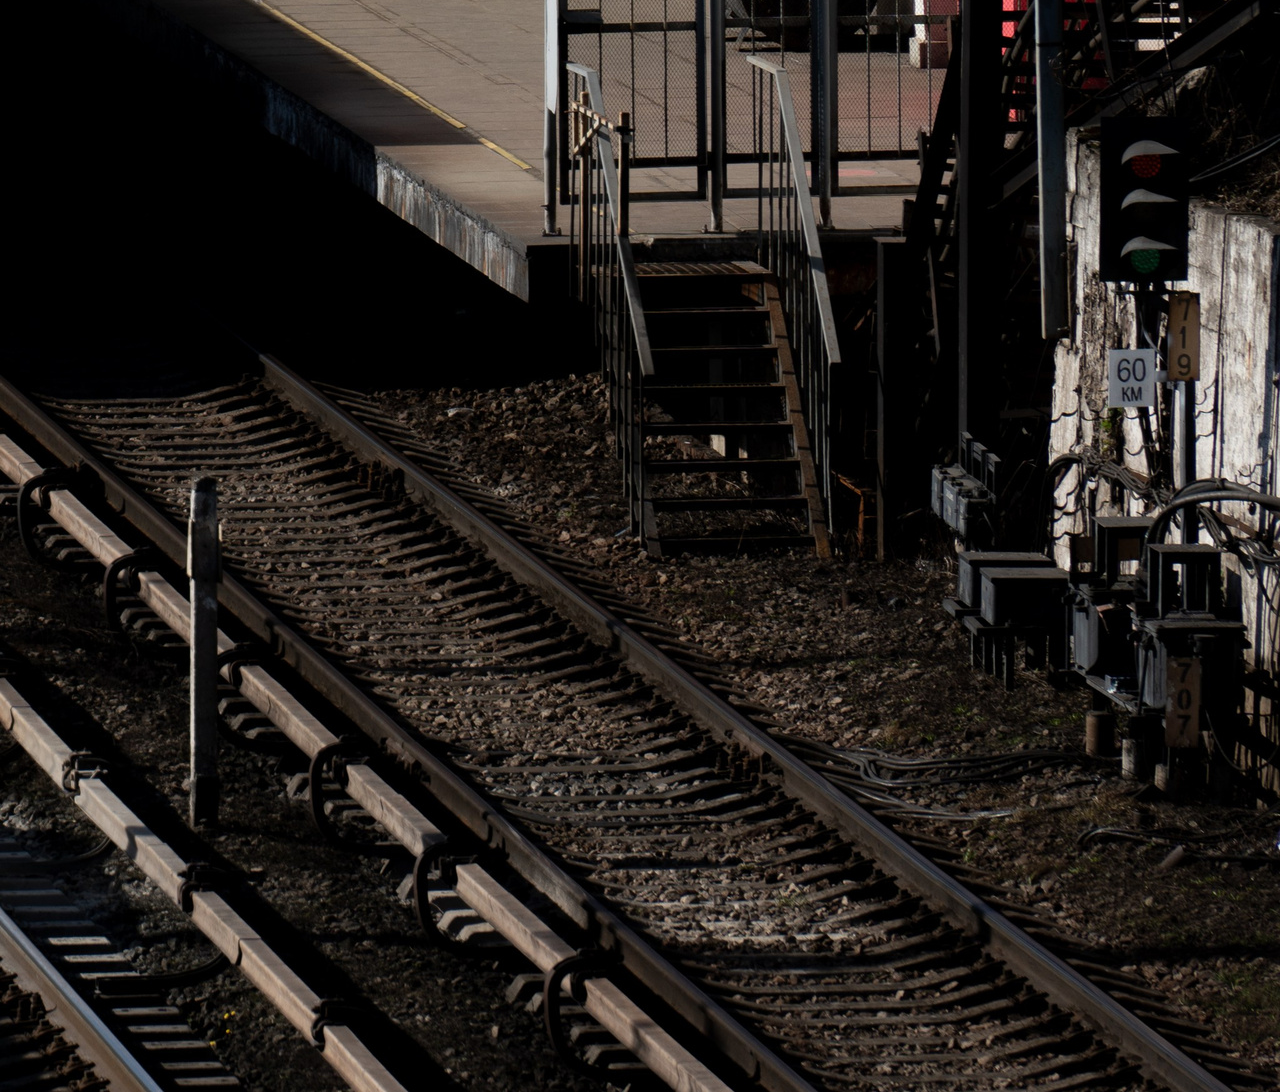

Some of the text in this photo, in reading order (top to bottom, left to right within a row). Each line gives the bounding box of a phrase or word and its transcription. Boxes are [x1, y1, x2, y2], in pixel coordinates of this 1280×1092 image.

[1117, 358, 1146, 383] 60
[1177, 298, 1191, 377] 719
[1177, 662, 1193, 735] 707
